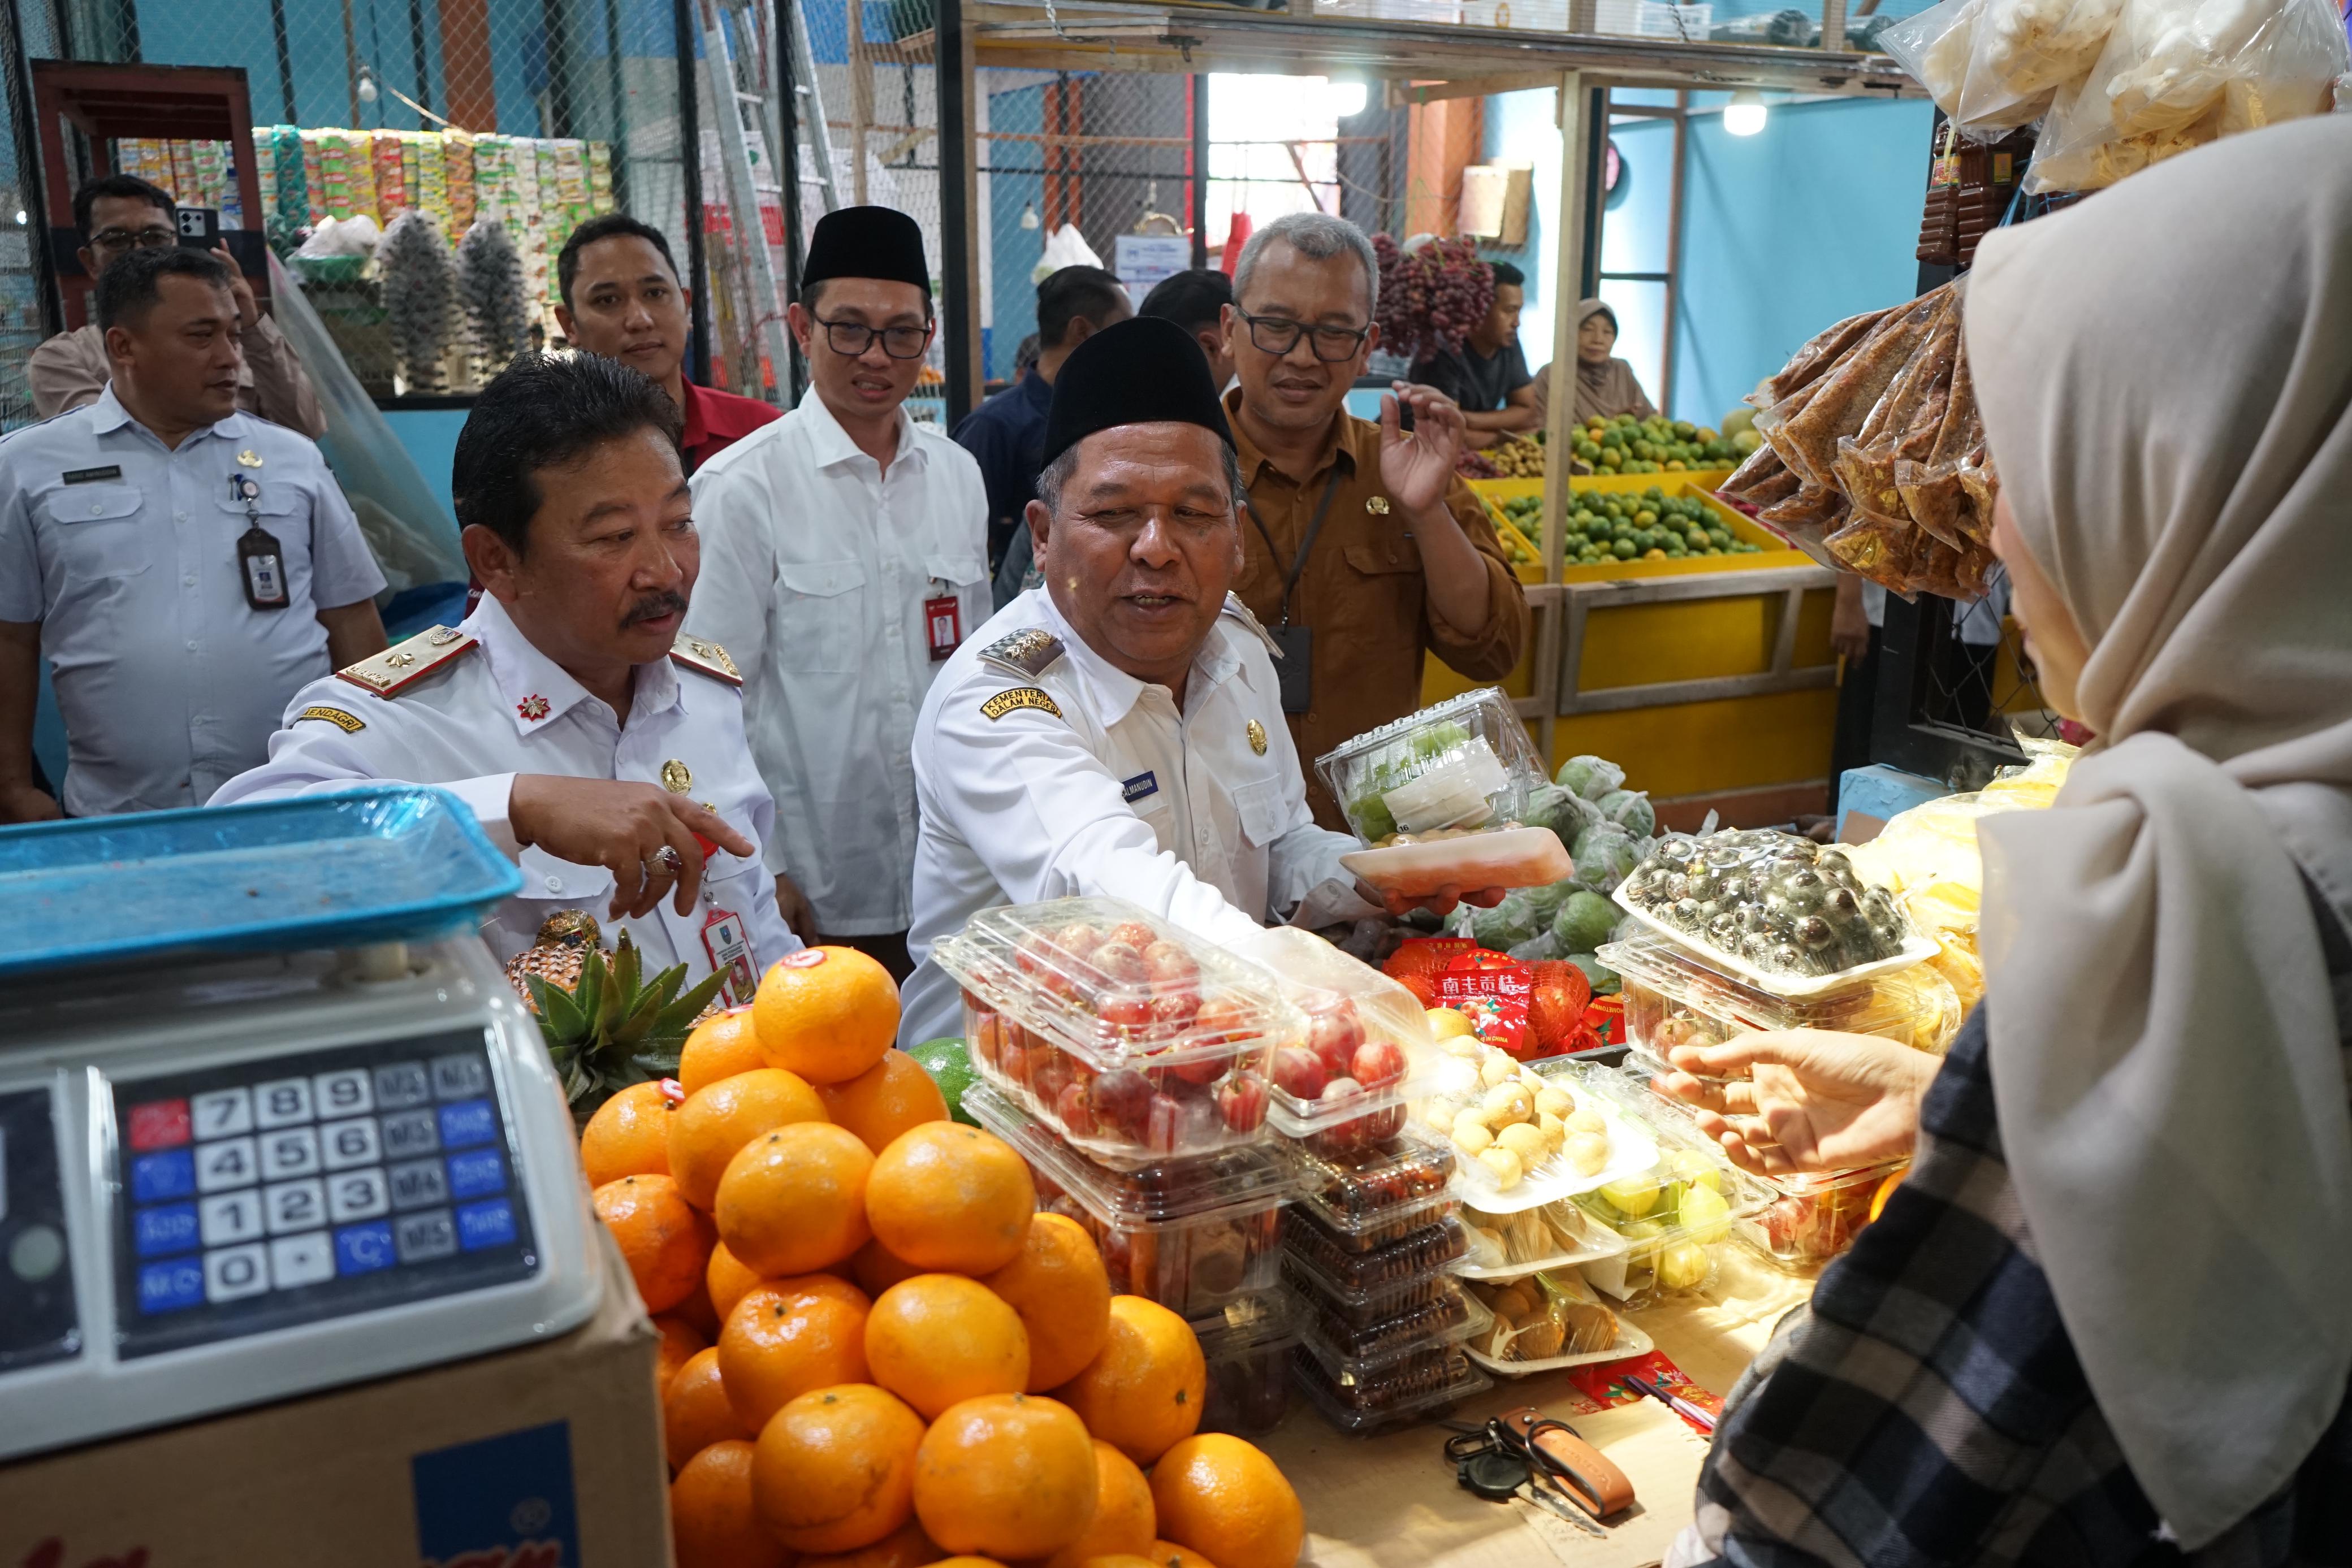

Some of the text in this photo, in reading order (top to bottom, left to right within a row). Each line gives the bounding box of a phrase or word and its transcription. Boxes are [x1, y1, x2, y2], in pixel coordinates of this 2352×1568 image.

[986, 690, 1055, 710] KEMENTERIA
[992, 699, 1024, 716] DALAM
[1594, 1004, 1624, 1013] HOMETOWN
[204, 1098, 238, 1127] 7
[271, 1086, 300, 1115] 8
[331, 1077, 361, 1106] 9
[211, 1148, 245, 1175] 4
[276, 1136, 308, 1167] 5
[338, 1128, 368, 1156] 6
[218, 1202, 243, 1231] 1
[280, 1189, 314, 1221] 2
[342, 1180, 375, 1210] 3
[219, 1254, 257, 1286] 0
[349, 1230, 383, 1264] C
